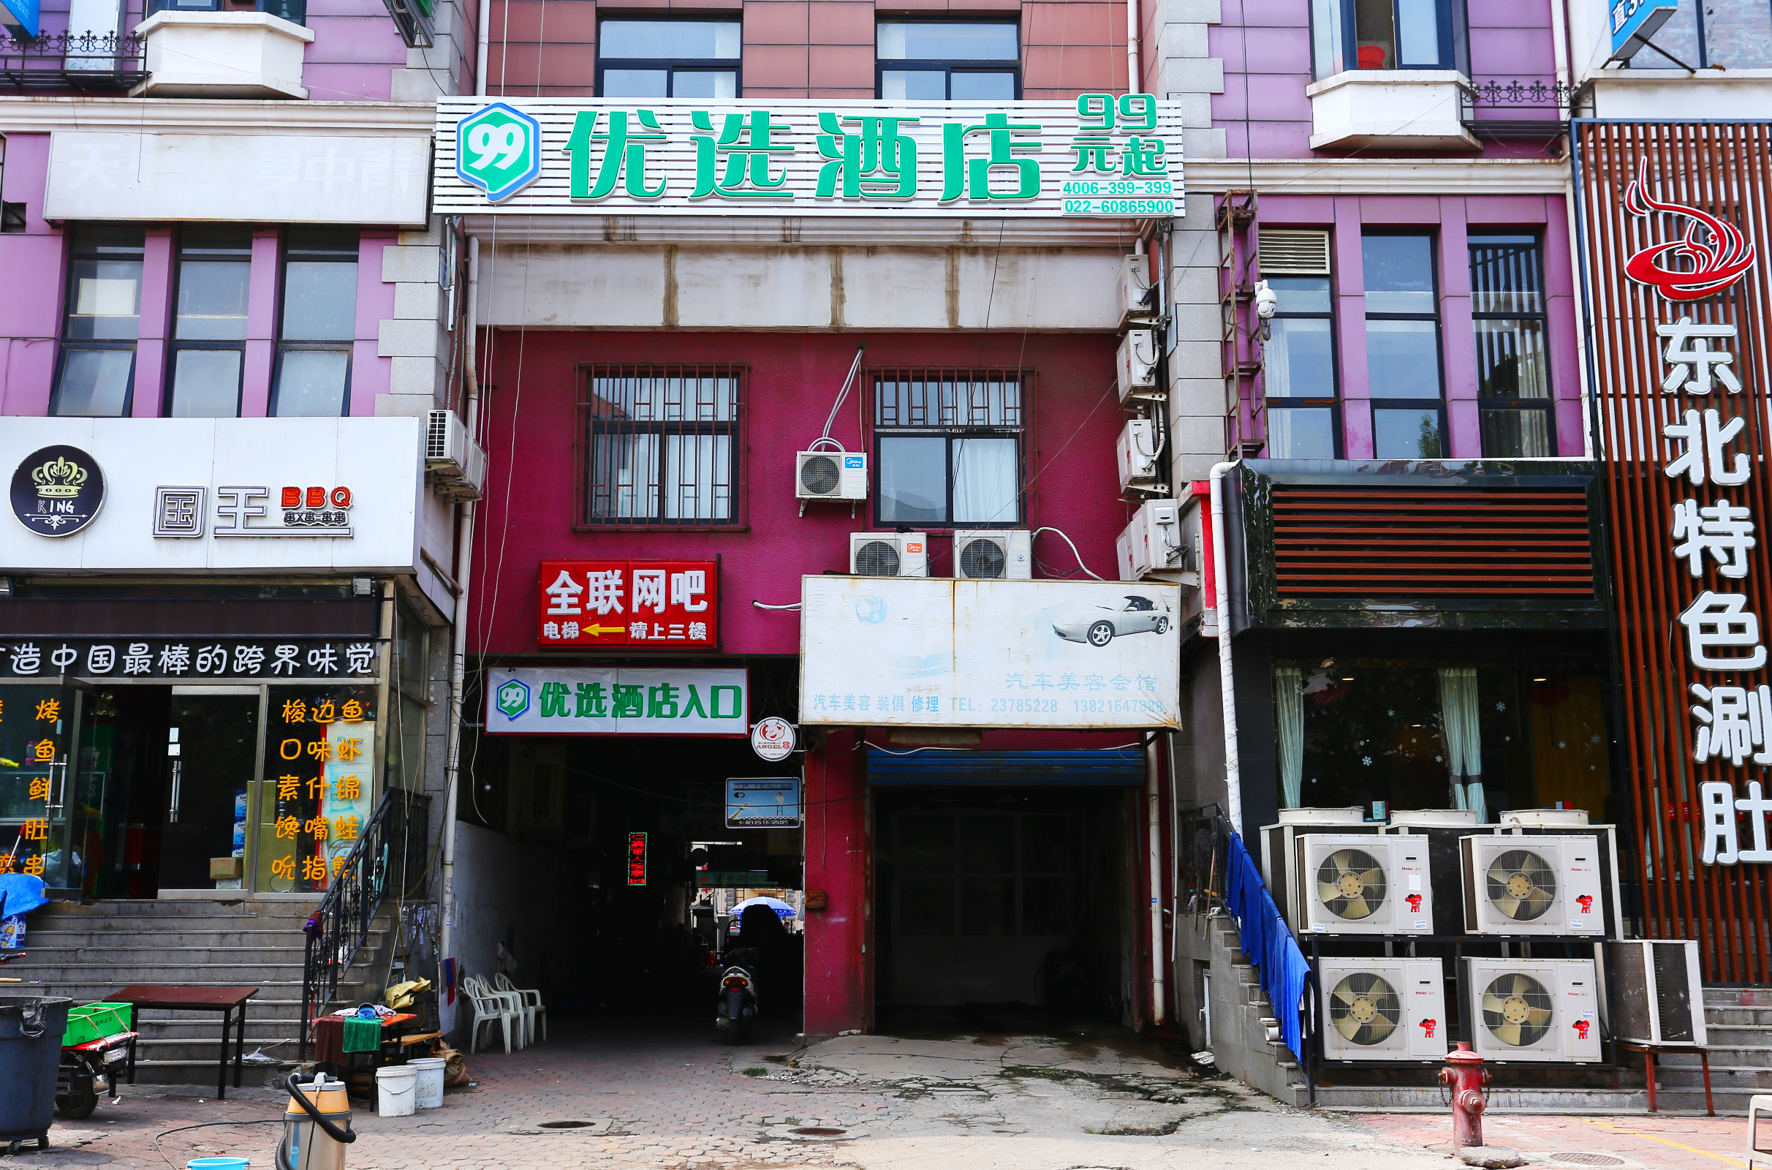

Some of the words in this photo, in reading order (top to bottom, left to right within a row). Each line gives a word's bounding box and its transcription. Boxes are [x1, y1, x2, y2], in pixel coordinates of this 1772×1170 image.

[1077, 93, 1157, 132] 99
[467, 122, 525, 170] 99
[561, 108, 1043, 205] 优选酒店
[1070, 136, 1168, 177] 元起
[1063, 181, 1172, 195] 4006-399-399
[1065, 200, 1173, 213] 022-60865900
[37, 499, 75, 514] KING
[281, 486, 352, 508] BBQ
[153, 485, 354, 539] 国王
[545, 569, 708, 615] 全联网吧
[1656, 316, 1772, 865] 东北特色涮肚
[543, 621, 580, 639] 电梯
[629, 621, 707, 640] 请上三楼
[0, 642, 375, 676] 造中国最棒的跨界味觉
[1005, 673, 1157, 692] 汽车美容会馆
[501, 687, 524, 708] 99
[539, 681, 742, 718] 优选酒店入口
[813, 694, 871, 711] 汽车美容
[911, 695, 939, 712] 修理
[991, 698, 1058, 713] 23785228
[282, 699, 363, 724] 梭边鱼
[34, 738, 56, 762] 鱼
[280, 737, 362, 762] 口味虾
[277, 774, 361, 801] 素什锦
[275, 815, 360, 840] 馋嘴蛙
